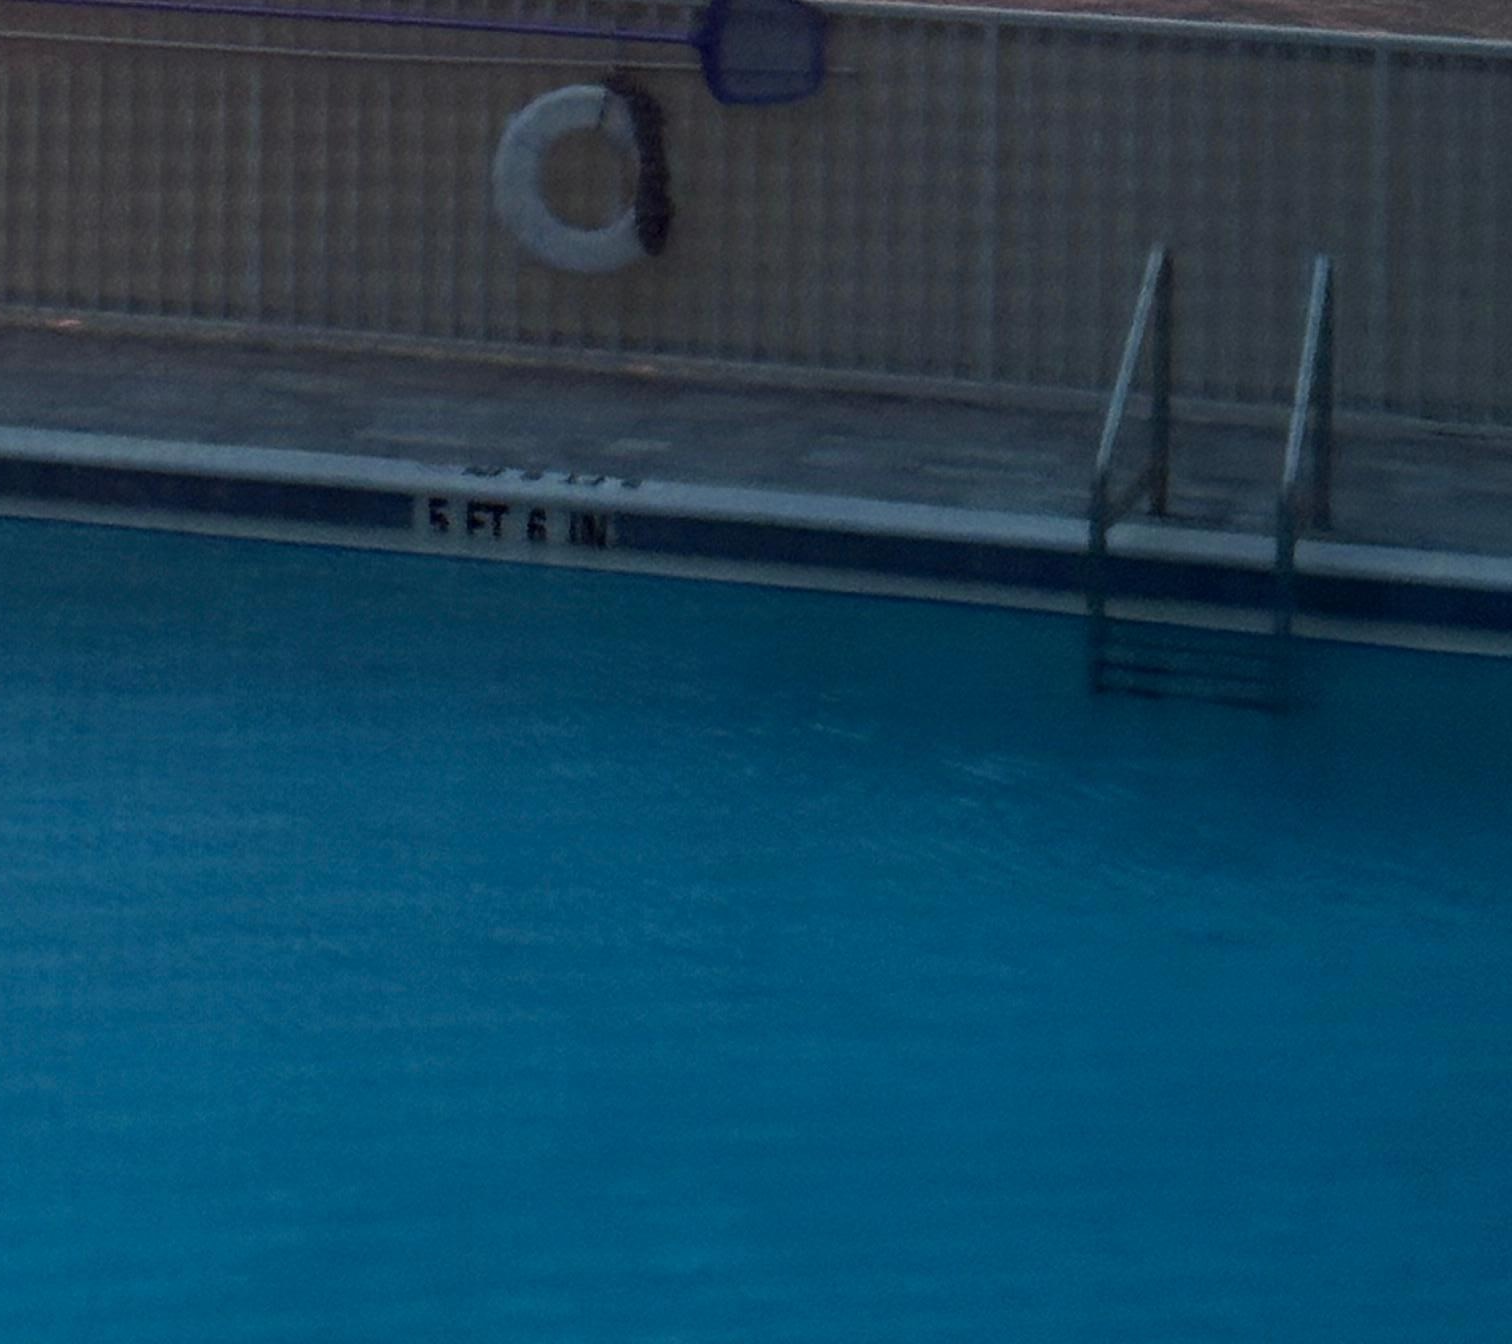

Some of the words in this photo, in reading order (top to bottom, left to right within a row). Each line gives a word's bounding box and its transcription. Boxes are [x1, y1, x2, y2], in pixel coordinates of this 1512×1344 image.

[428, 496, 450, 533] 5
[467, 499, 509, 537] FT
[568, 510, 609, 548] IN
